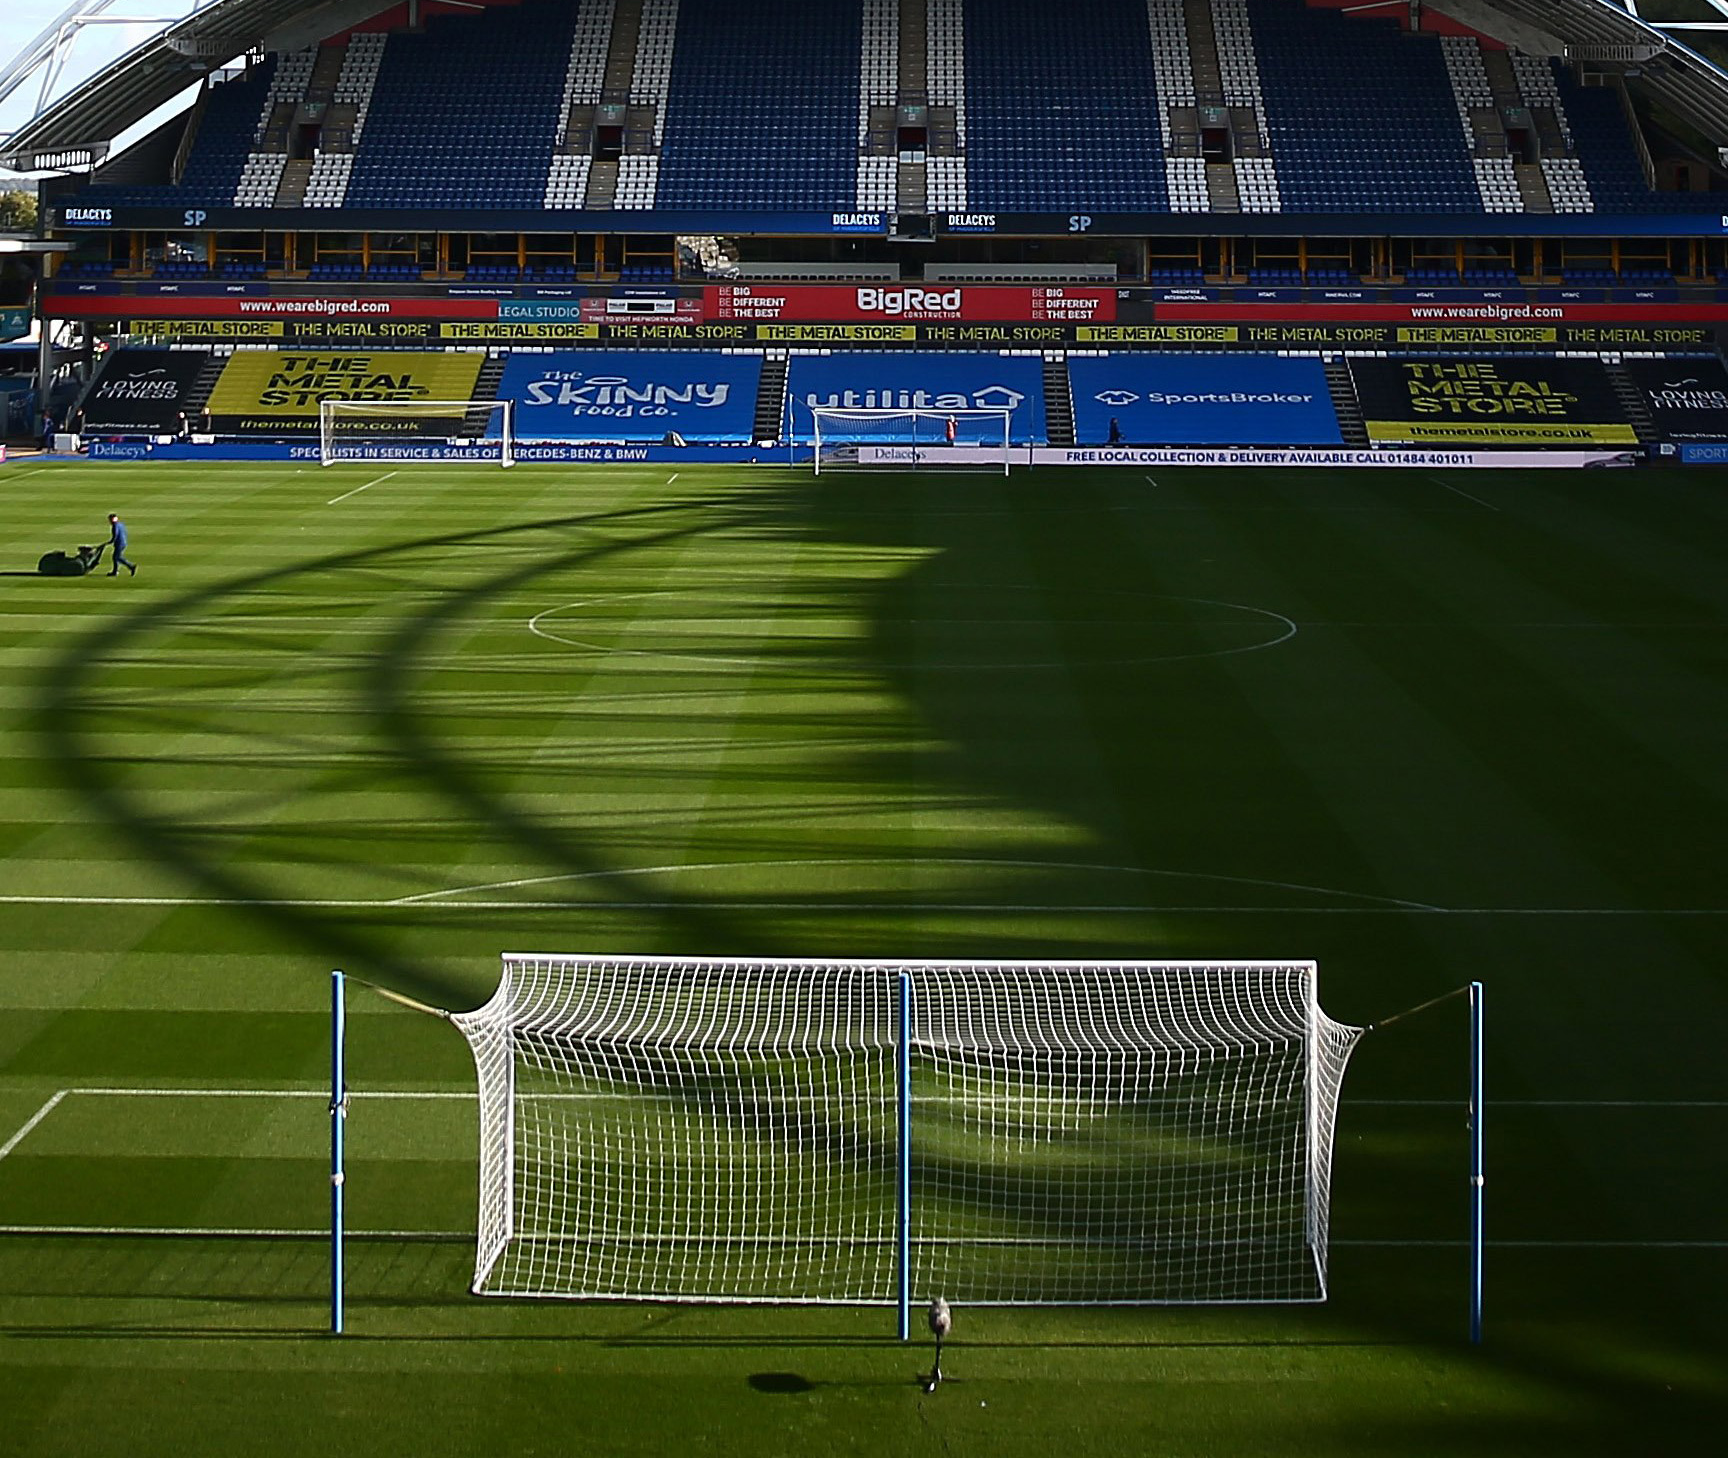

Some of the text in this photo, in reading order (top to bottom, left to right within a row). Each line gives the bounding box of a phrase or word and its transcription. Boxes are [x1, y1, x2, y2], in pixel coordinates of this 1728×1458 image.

[65, 209, 112, 220] DELACEYS
[184, 210, 207, 226] SP
[833, 214, 880, 225] DELACEYS
[948, 214, 996, 226] DELACEYS
[1069, 216, 1092, 231] SP
[719, 287, 750, 295] BE BIG
[1032, 289, 1063, 297] BE BIG
[240, 300, 390, 315] www.wearebigred.com
[719, 297, 786, 307] BE DIFFERENT
[857, 289, 961, 315] BigRed
[1032, 299, 1099, 308] BE DIFFERENT
[499, 306, 580, 318] LEGAL STUDIO
[719, 308, 780, 317] BE THE BEST
[1032, 310, 1094, 319] BE THE BEST
[1411, 306, 1563, 320] www.wearebigred.com
[137, 322, 270, 335] THE METAL STORE
[293, 323, 426, 336] THE METAL STORE
[451, 324, 585, 337] THE METAL STORE
[610, 325, 743, 338] THE METAL STORE
[768, 326, 901, 338] THE METAL STORE
[927, 327, 1061, 339] THE METAL STORE
[1089, 328, 1224, 340] THE METAL STORE
[1249, 328, 1383, 340] THE METAL STORE
[1408, 329, 1543, 341] THE METAL STORE
[1567, 329, 1702, 342] THE METAL STORE
[280, 357, 372, 372] THE
[1402, 364, 1498, 379] THE
[102, 380, 177, 390] LOVING
[267, 373, 425, 389] METAL
[96, 390, 178, 399] FITNESS
[524, 382, 730, 407] SKINNY
[1409, 381, 1572, 396] METAL
[259, 390, 415, 406] STORE
[806, 390, 969, 409] utilita
[1149, 392, 1313, 404] SportsBroker
[1649, 390, 1727, 400] LOVING
[1412, 398, 1568, 415] STORE
[1409, 426, 1593, 439] themetalstore.co.uk
[94, 443, 146, 458] Delaceys
[365, 448, 648, 460] IN SERVICE & SALES OF & BMW
[1689, 447, 1727, 459] SPORT
[1067, 452, 1473, 465] FREE LOCAL COLLECTION & DELIVERY AVAILABLE CALL 01484 401011
